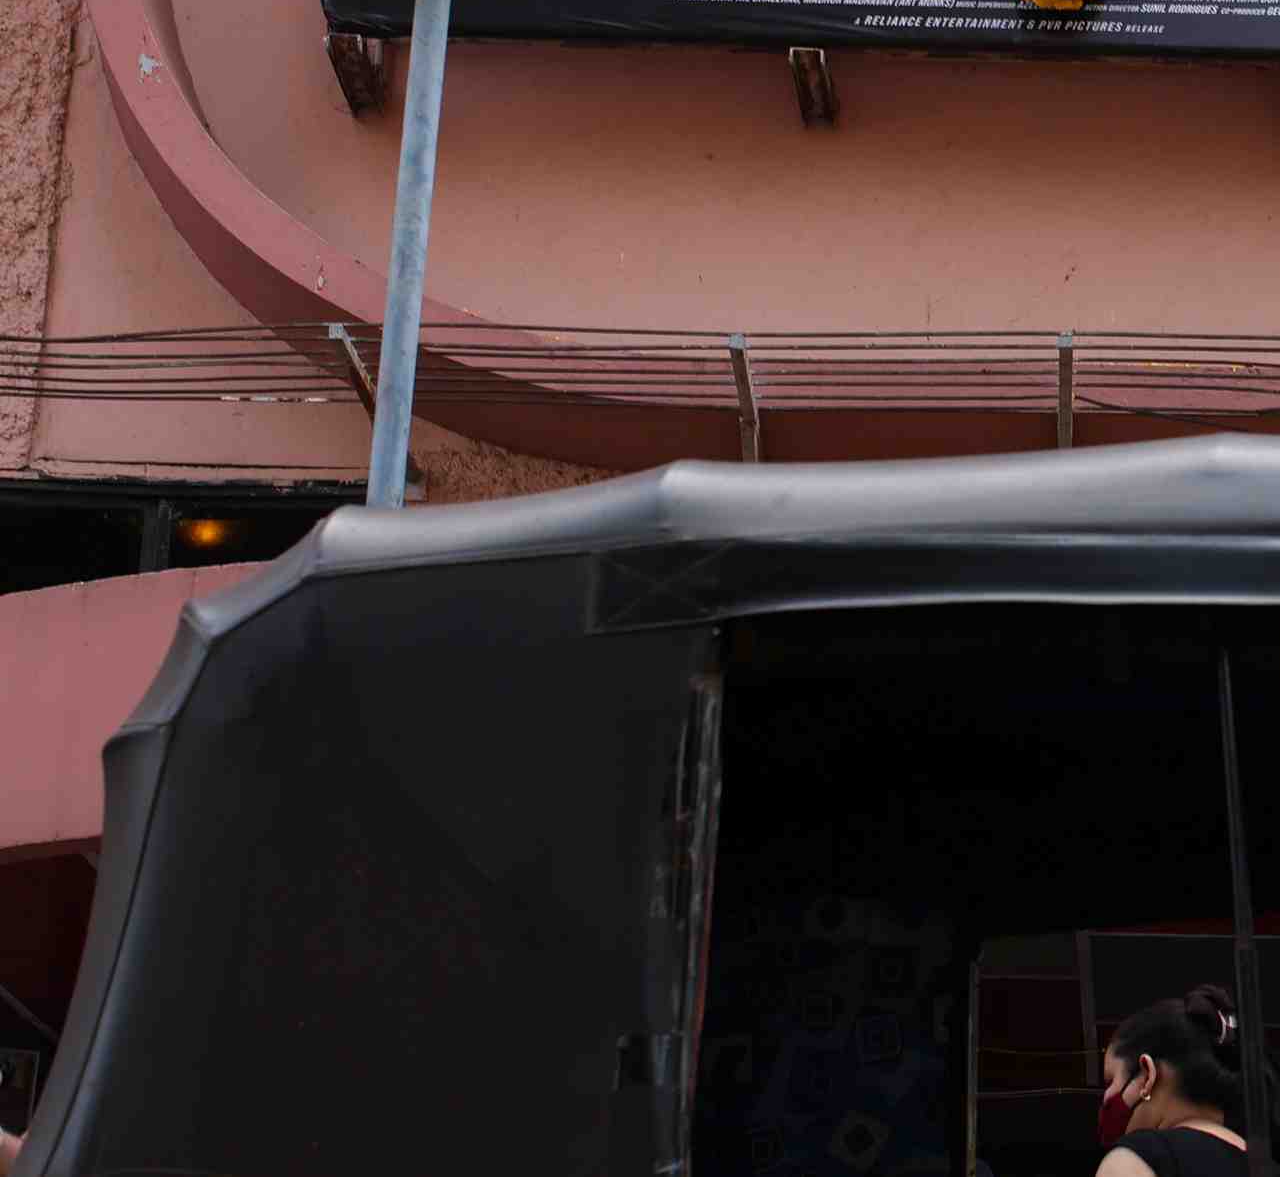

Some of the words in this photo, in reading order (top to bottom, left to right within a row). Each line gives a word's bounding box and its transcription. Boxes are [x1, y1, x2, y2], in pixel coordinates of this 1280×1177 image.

[864, 15, 924, 27] RELIANCE
[926, 16, 1025, 30] ENTERTAINMENT
[1040, 21, 1061, 31] PVR
[1064, 21, 1123, 33] PICTURES
